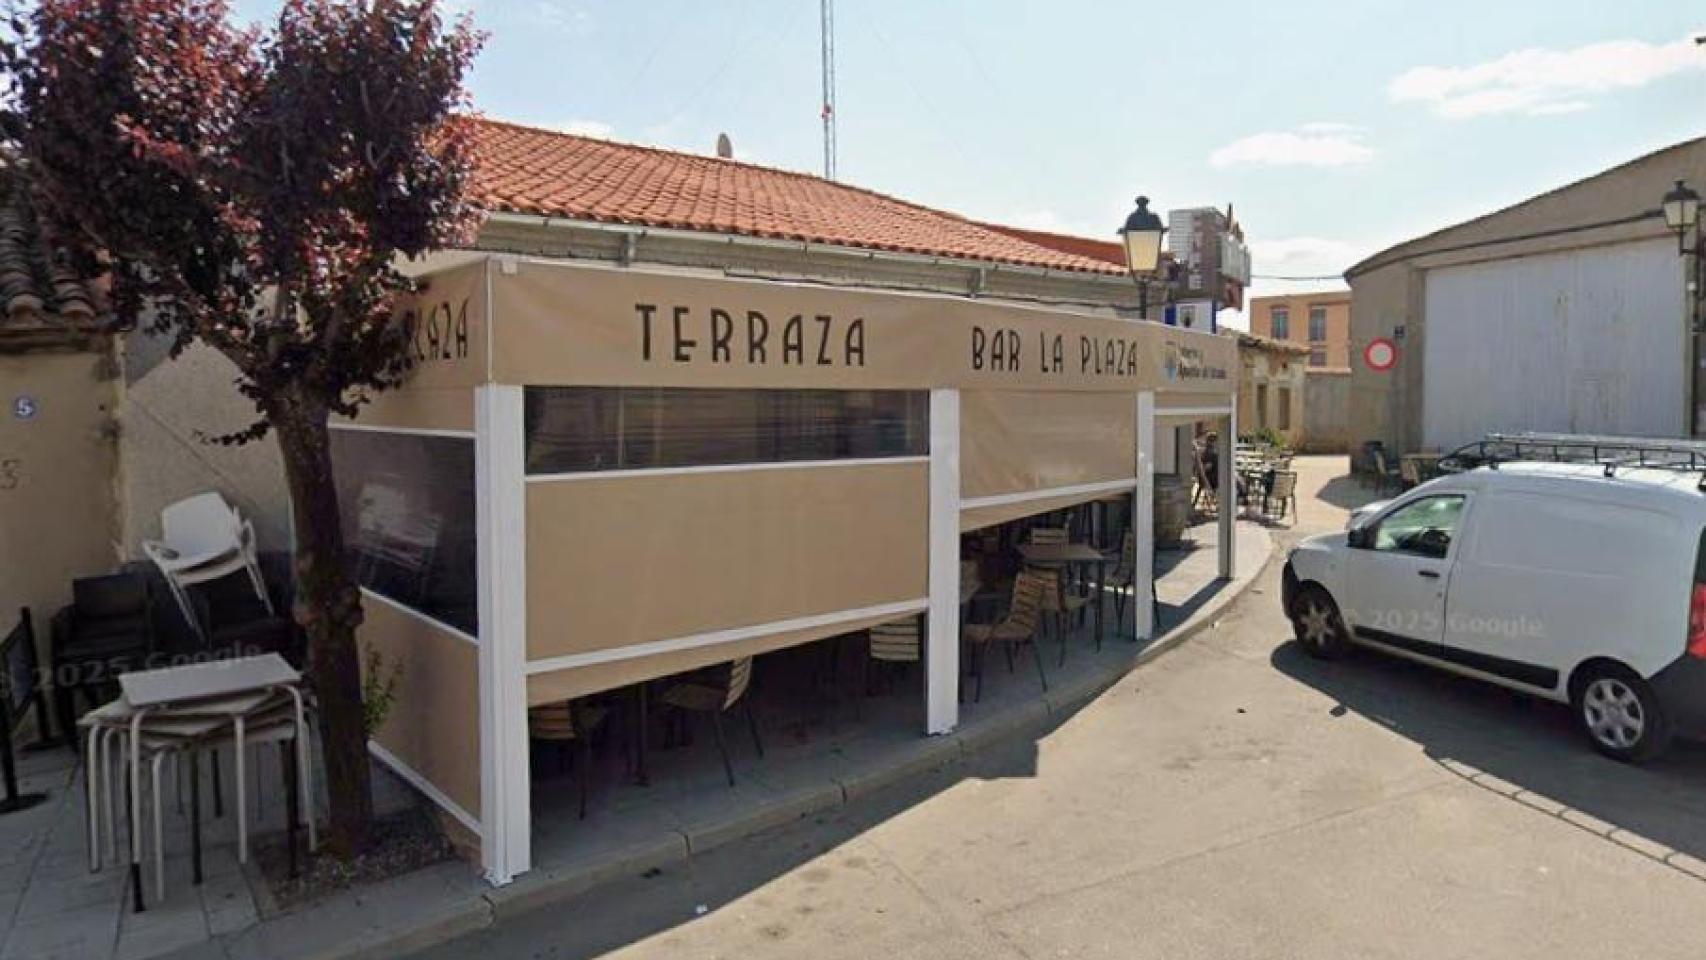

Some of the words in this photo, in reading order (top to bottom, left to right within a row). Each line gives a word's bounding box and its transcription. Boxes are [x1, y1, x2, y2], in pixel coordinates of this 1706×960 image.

[635, 303, 865, 367] TERRAZA
[972, 325, 1021, 372] BAR
[1040, 331, 1064, 373] LA
[1079, 335, 1138, 376] PLAZA
[16, 399, 34, 417] 5
